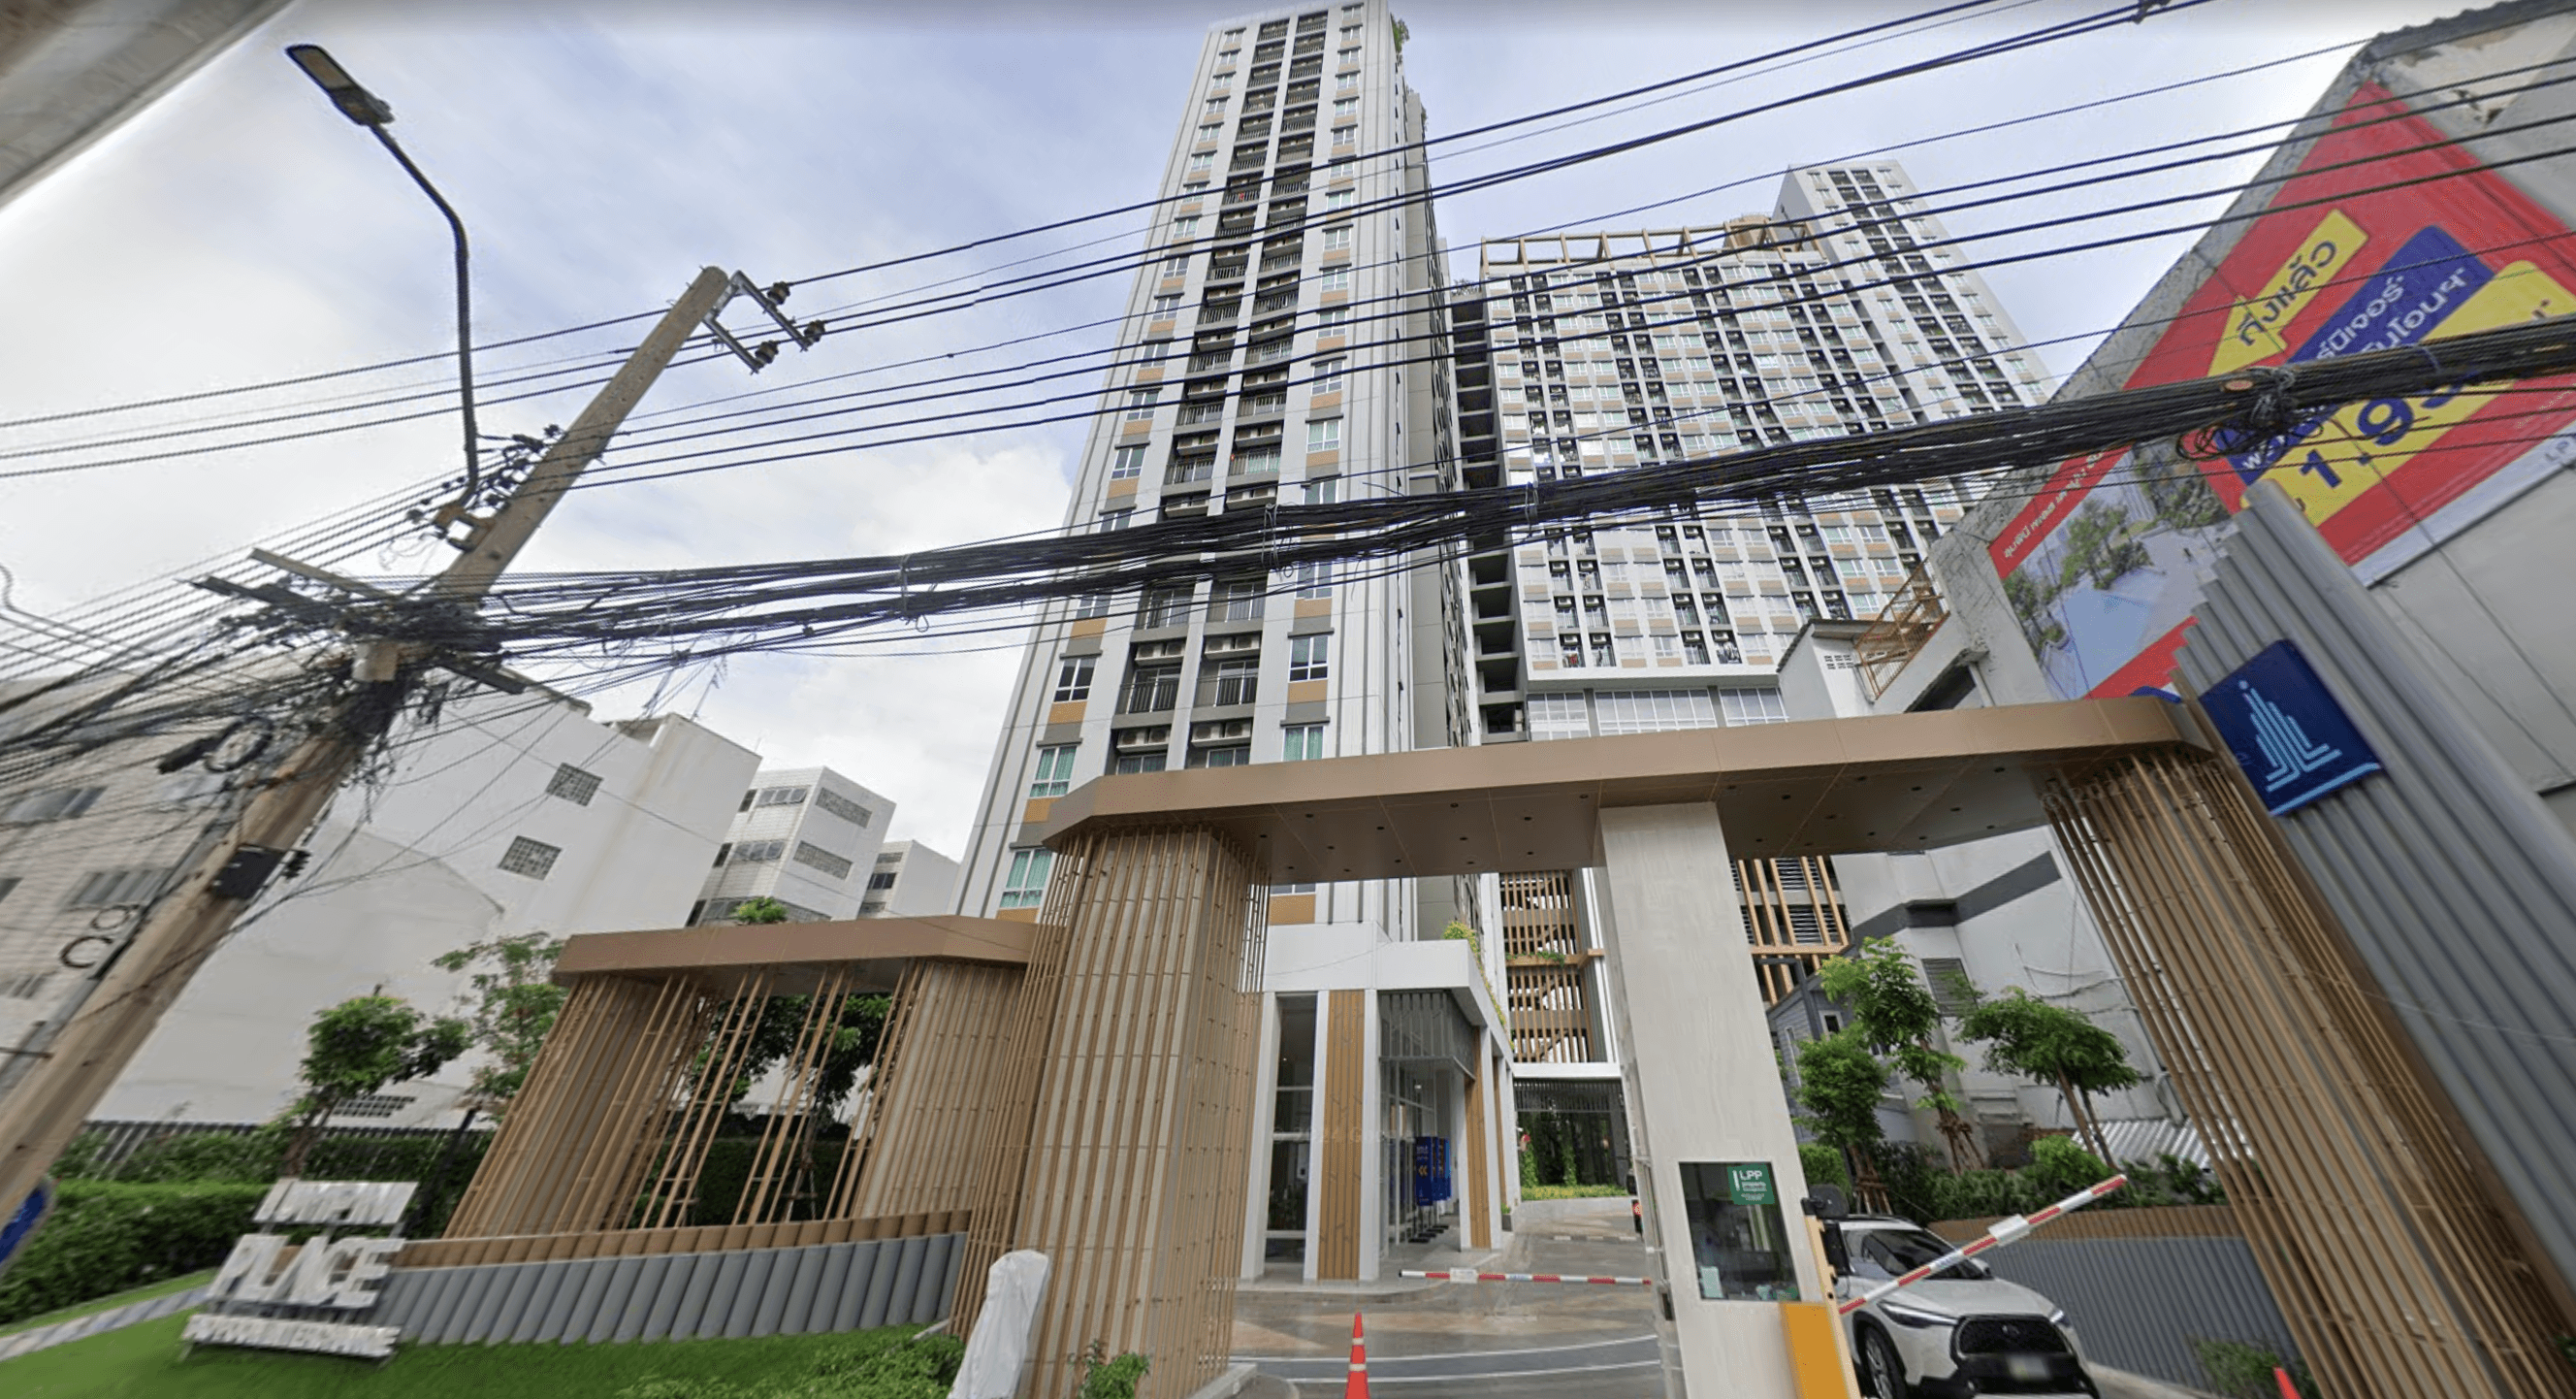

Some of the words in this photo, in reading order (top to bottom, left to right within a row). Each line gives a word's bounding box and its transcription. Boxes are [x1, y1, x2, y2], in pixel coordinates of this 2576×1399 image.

[2236, 240, 2337, 347] ถึงแล้ว
[2299, 376, 2468, 489] 1.9
[1739, 1169, 1763, 1181] LPP
[206, 1233, 407, 1309] PLACE
